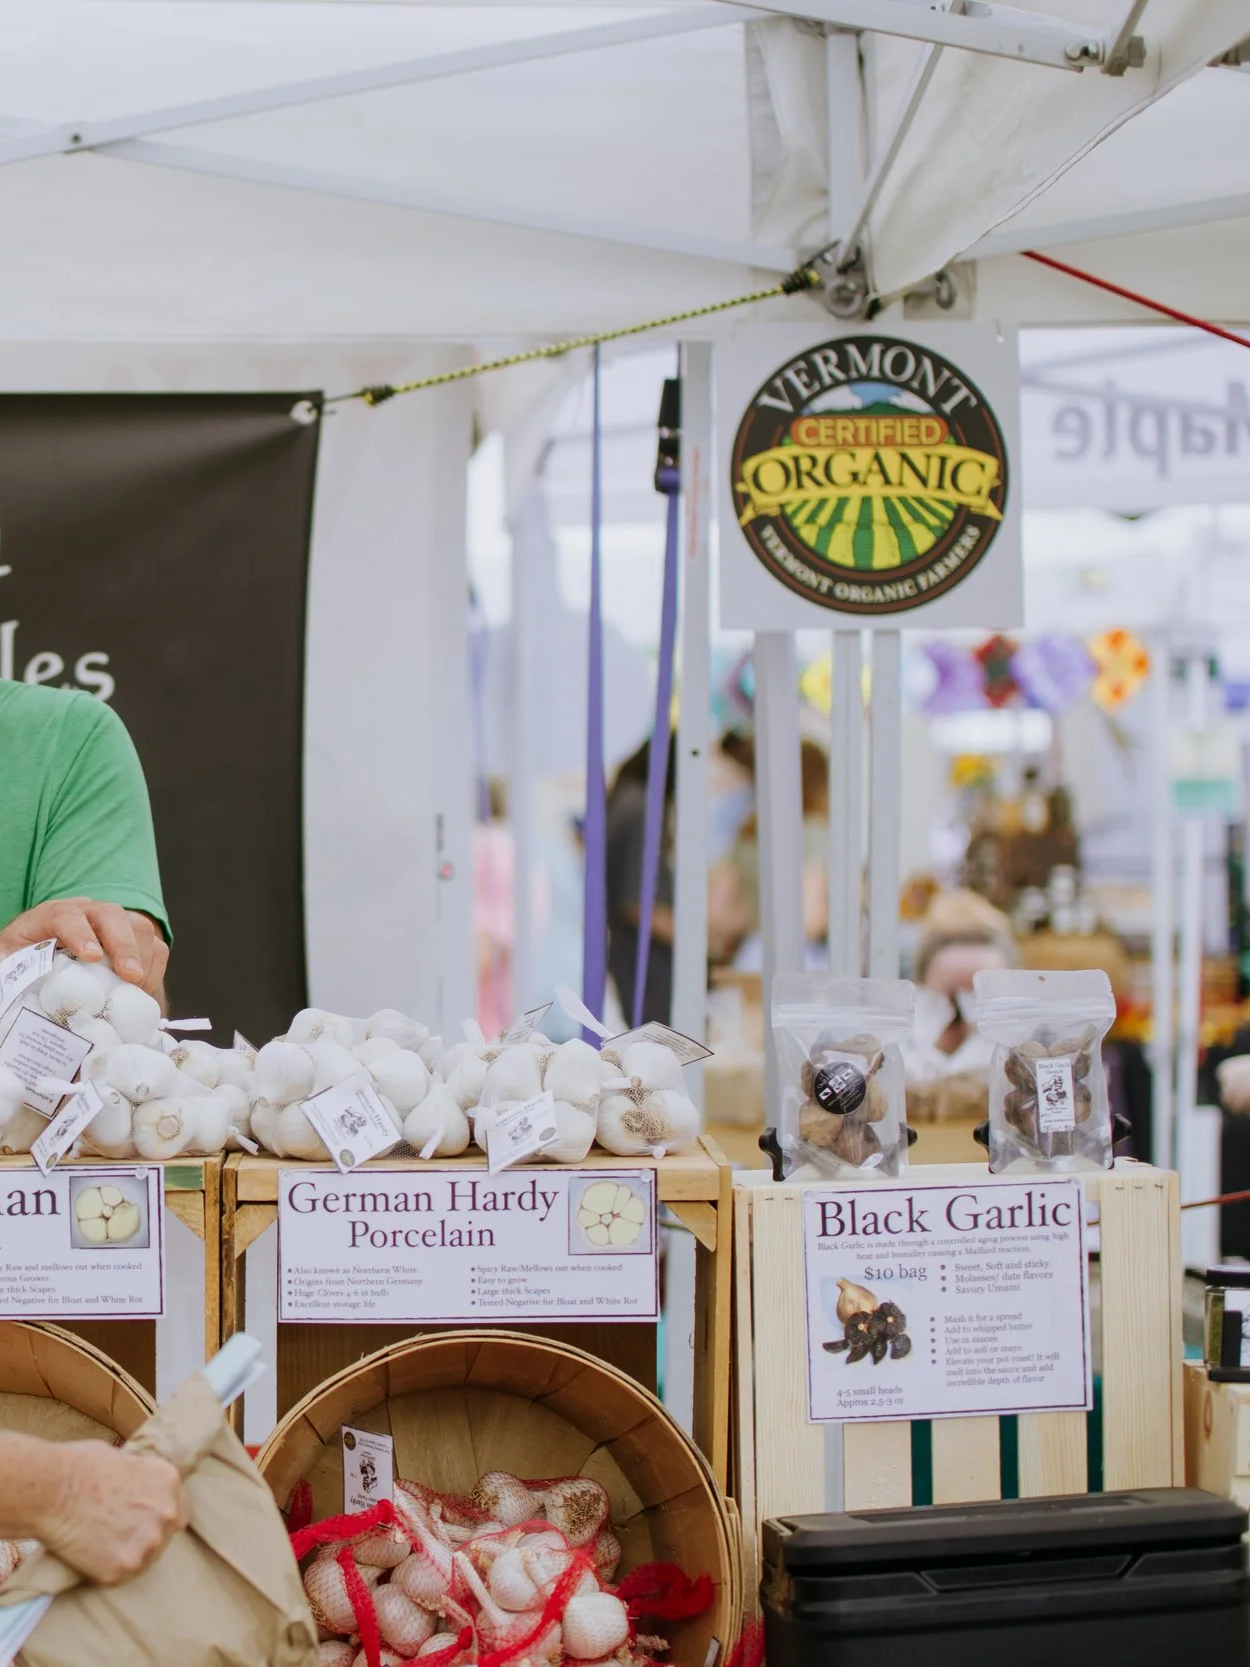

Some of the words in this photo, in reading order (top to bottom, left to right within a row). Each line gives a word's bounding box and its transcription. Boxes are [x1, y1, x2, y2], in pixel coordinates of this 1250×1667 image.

[758, 342, 979, 417] VERMONT
[798, 417, 942, 446] CERTIFIED
[752, 449, 987, 497] ORGANIC
[760, 523, 834, 594] VERMONT
[833, 579, 917, 604] ORGANIC
[915, 523, 981, 592] FARMERS
[288, 1181, 432, 1214] German
[446, 1179, 560, 1221] Hardy
[816, 1196, 932, 1238] Black
[945, 1191, 1072, 1232] Garlic
[348, 1218, 497, 1249] Porcelain
[478, 1276, 496, 1286] Easy
[508, 1278, 528, 1286] grow
[864, 1264, 894, 1282] $10
[898, 1264, 927, 1281] bag
[954, 1262, 984, 1273] Sweet,
[985, 1261, 1003, 1270] Soft
[1005, 1261, 1022, 1269] and
[1024, 1259, 1049, 1270] sticky
[29, 1286, 55, 1295] Scapes
[294, 1277, 323, 1287] Origins
[325, 1277, 345, 1285] from
[347, 1277, 384, 1285] Northern
[386, 1277, 423, 1287] Germany
